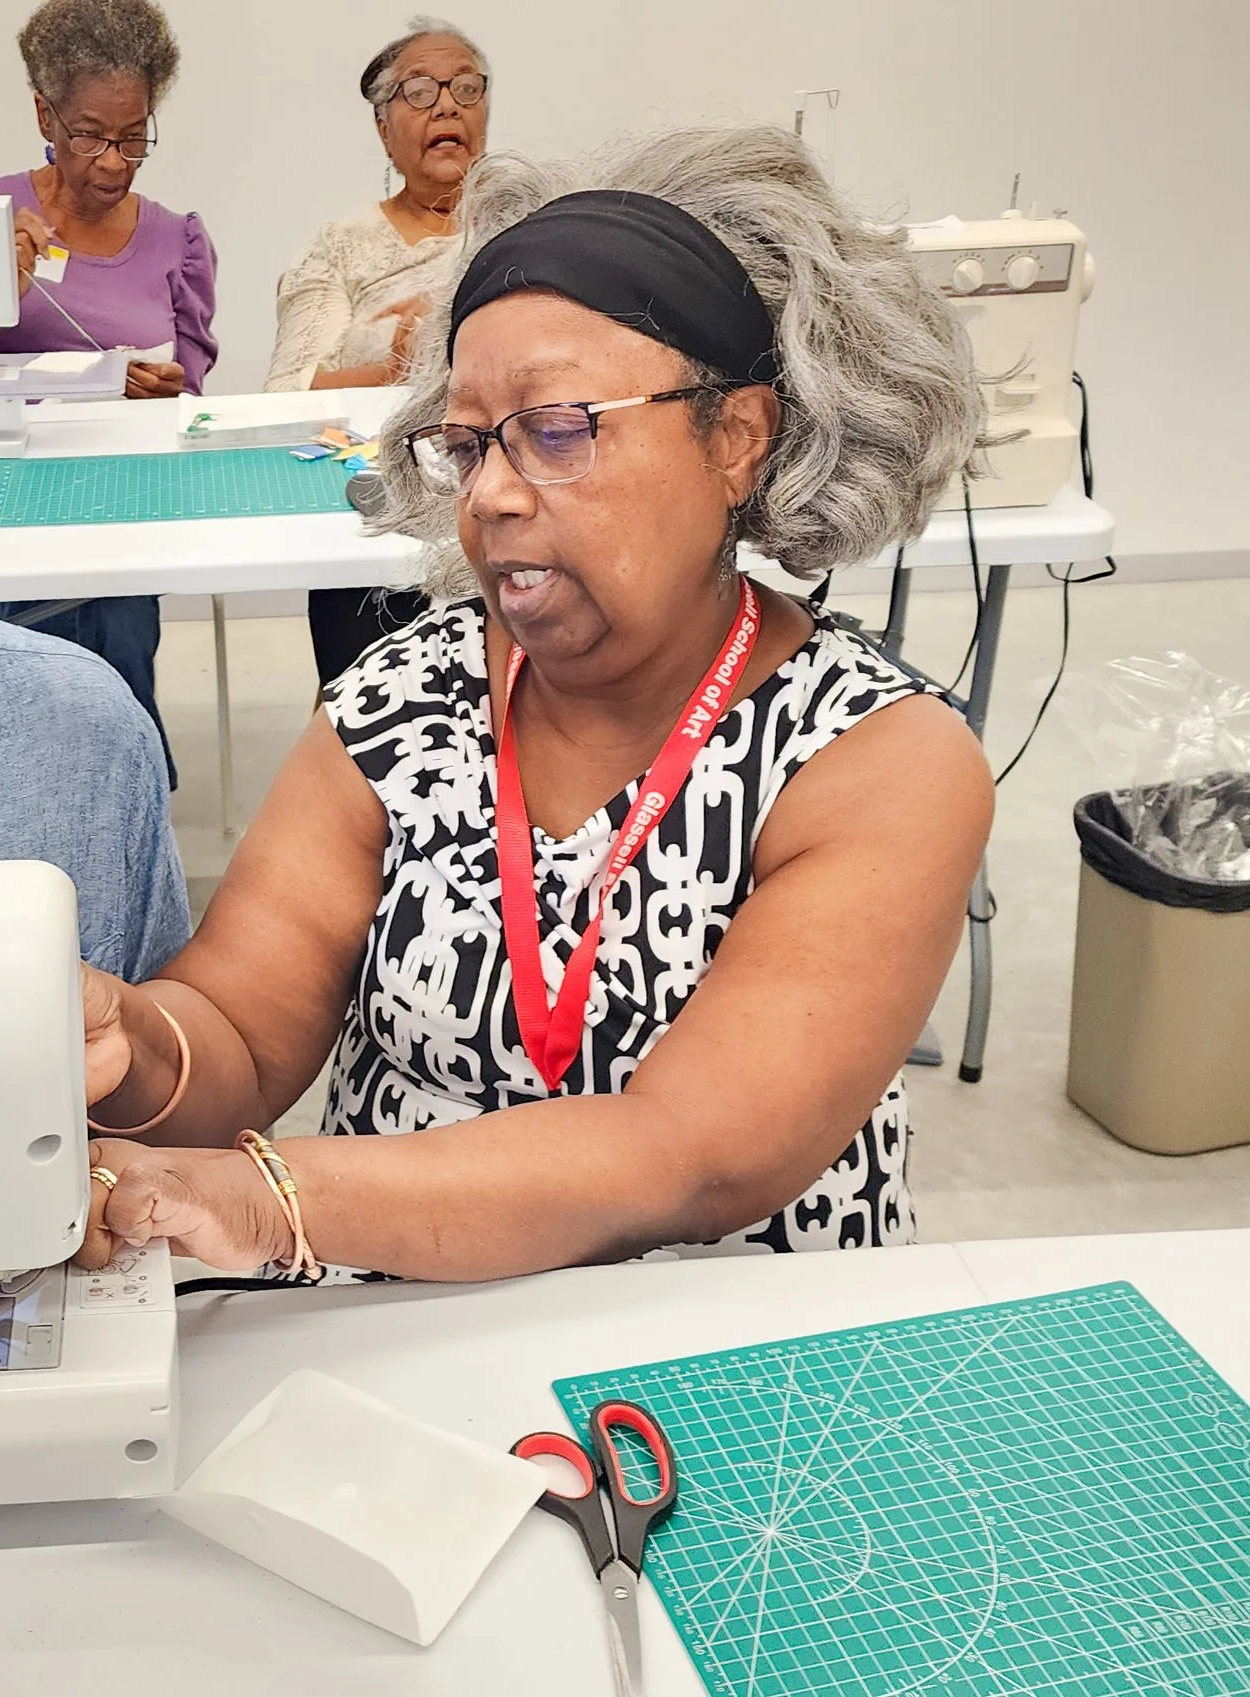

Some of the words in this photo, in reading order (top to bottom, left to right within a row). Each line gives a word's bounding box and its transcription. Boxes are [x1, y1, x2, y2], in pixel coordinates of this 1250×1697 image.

[714, 616, 755, 686] School
[681, 705, 712, 739] Art
[701, 685, 721, 710] of
[612, 791, 666, 870] Glassell
